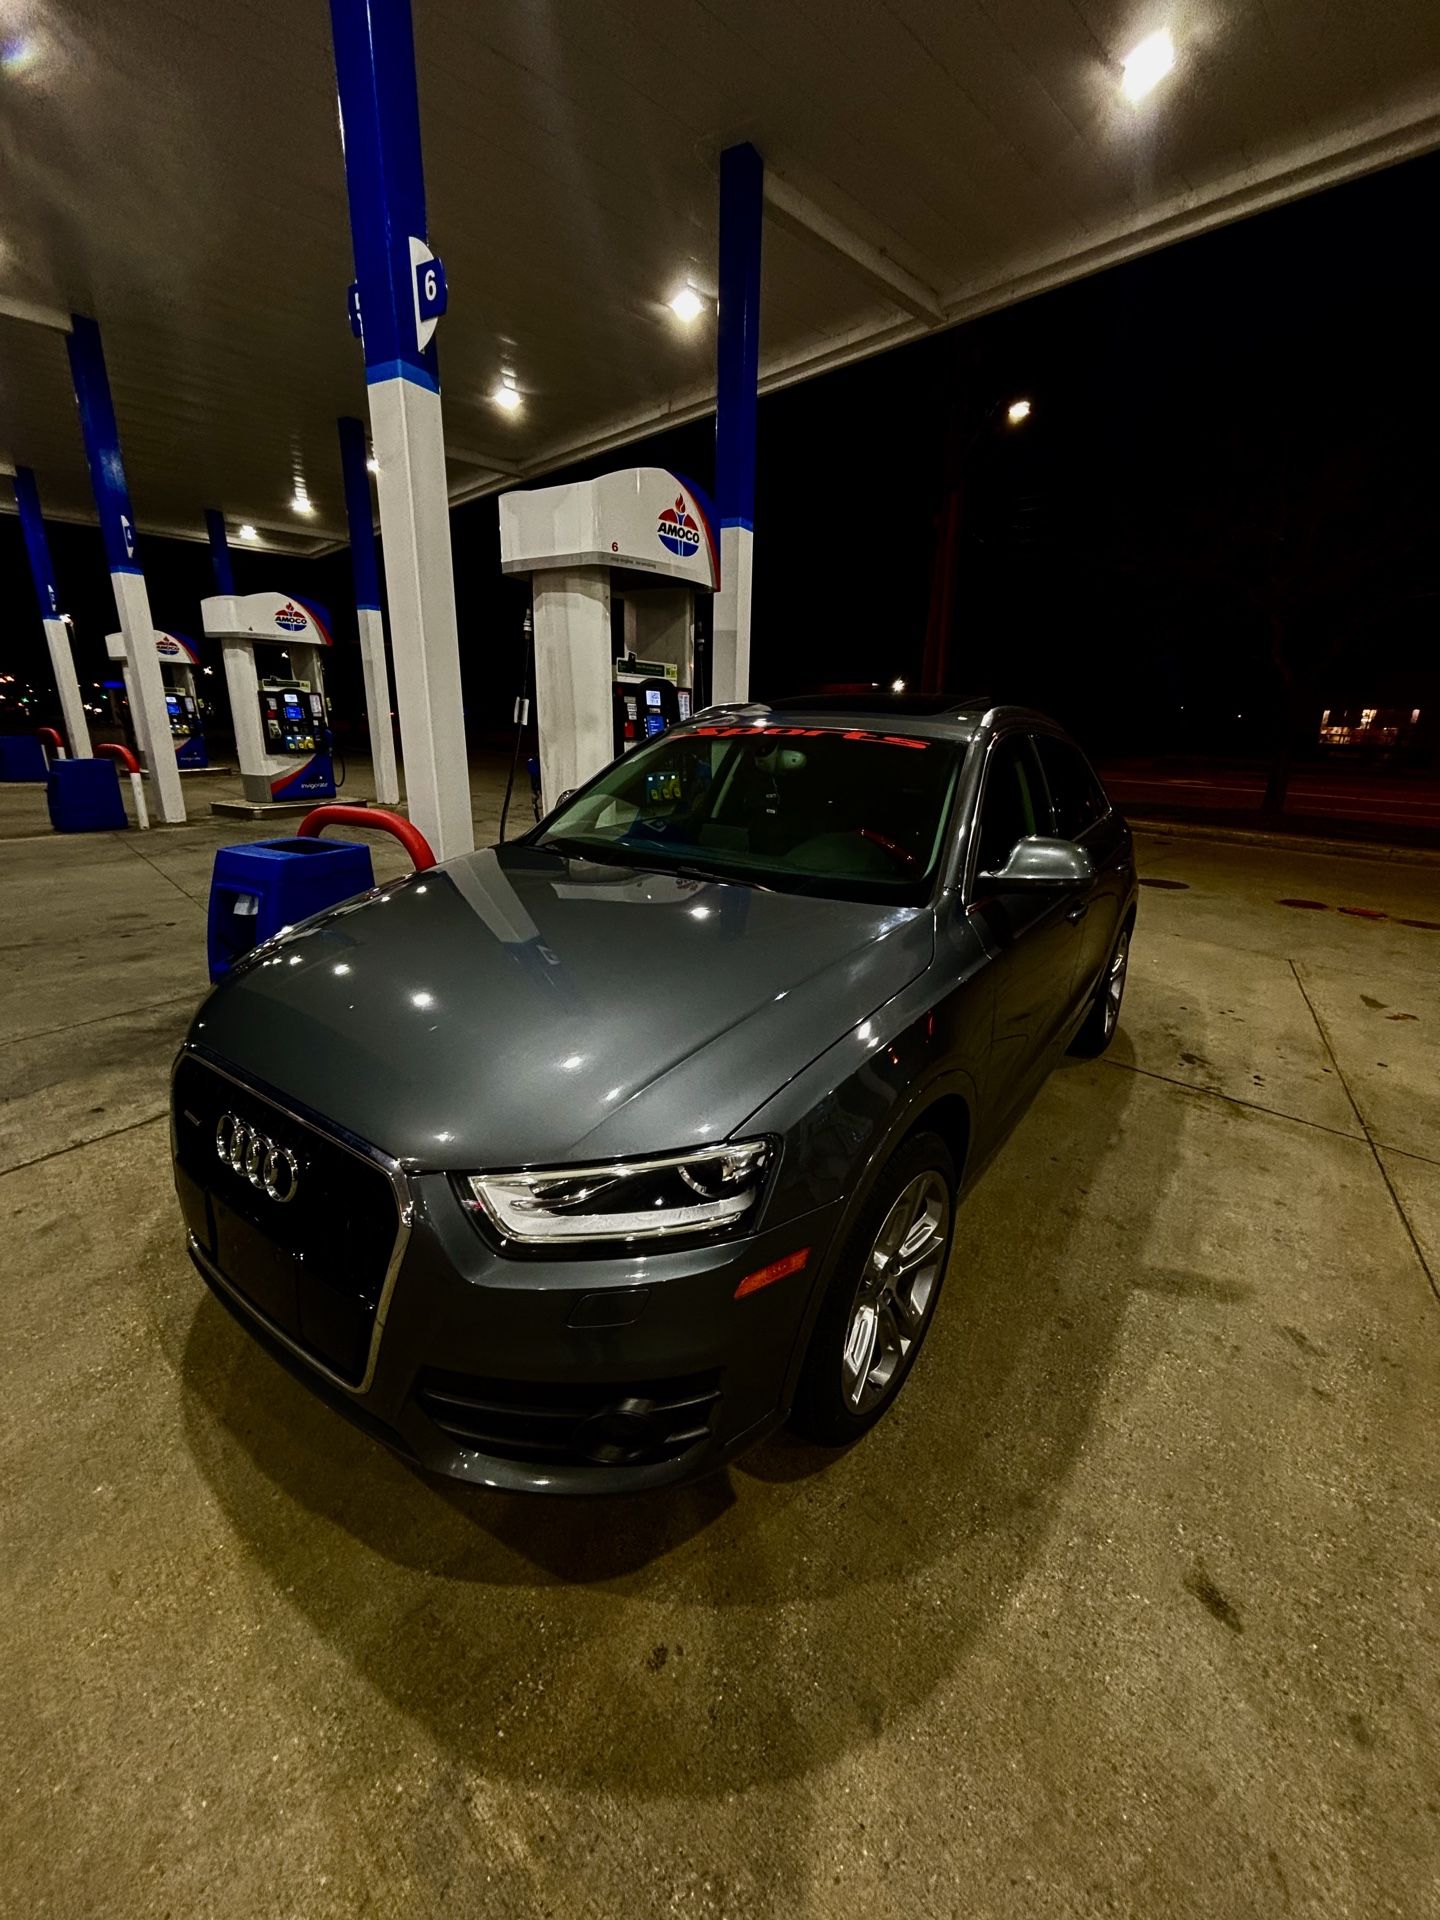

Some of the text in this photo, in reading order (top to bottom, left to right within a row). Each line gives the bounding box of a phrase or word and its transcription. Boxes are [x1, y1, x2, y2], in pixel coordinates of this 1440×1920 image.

[424, 269, 437, 301] 6
[657, 522, 700, 544] AMOCO
[611, 541, 619, 552] 6
[274, 616, 307, 625] AMOCO
